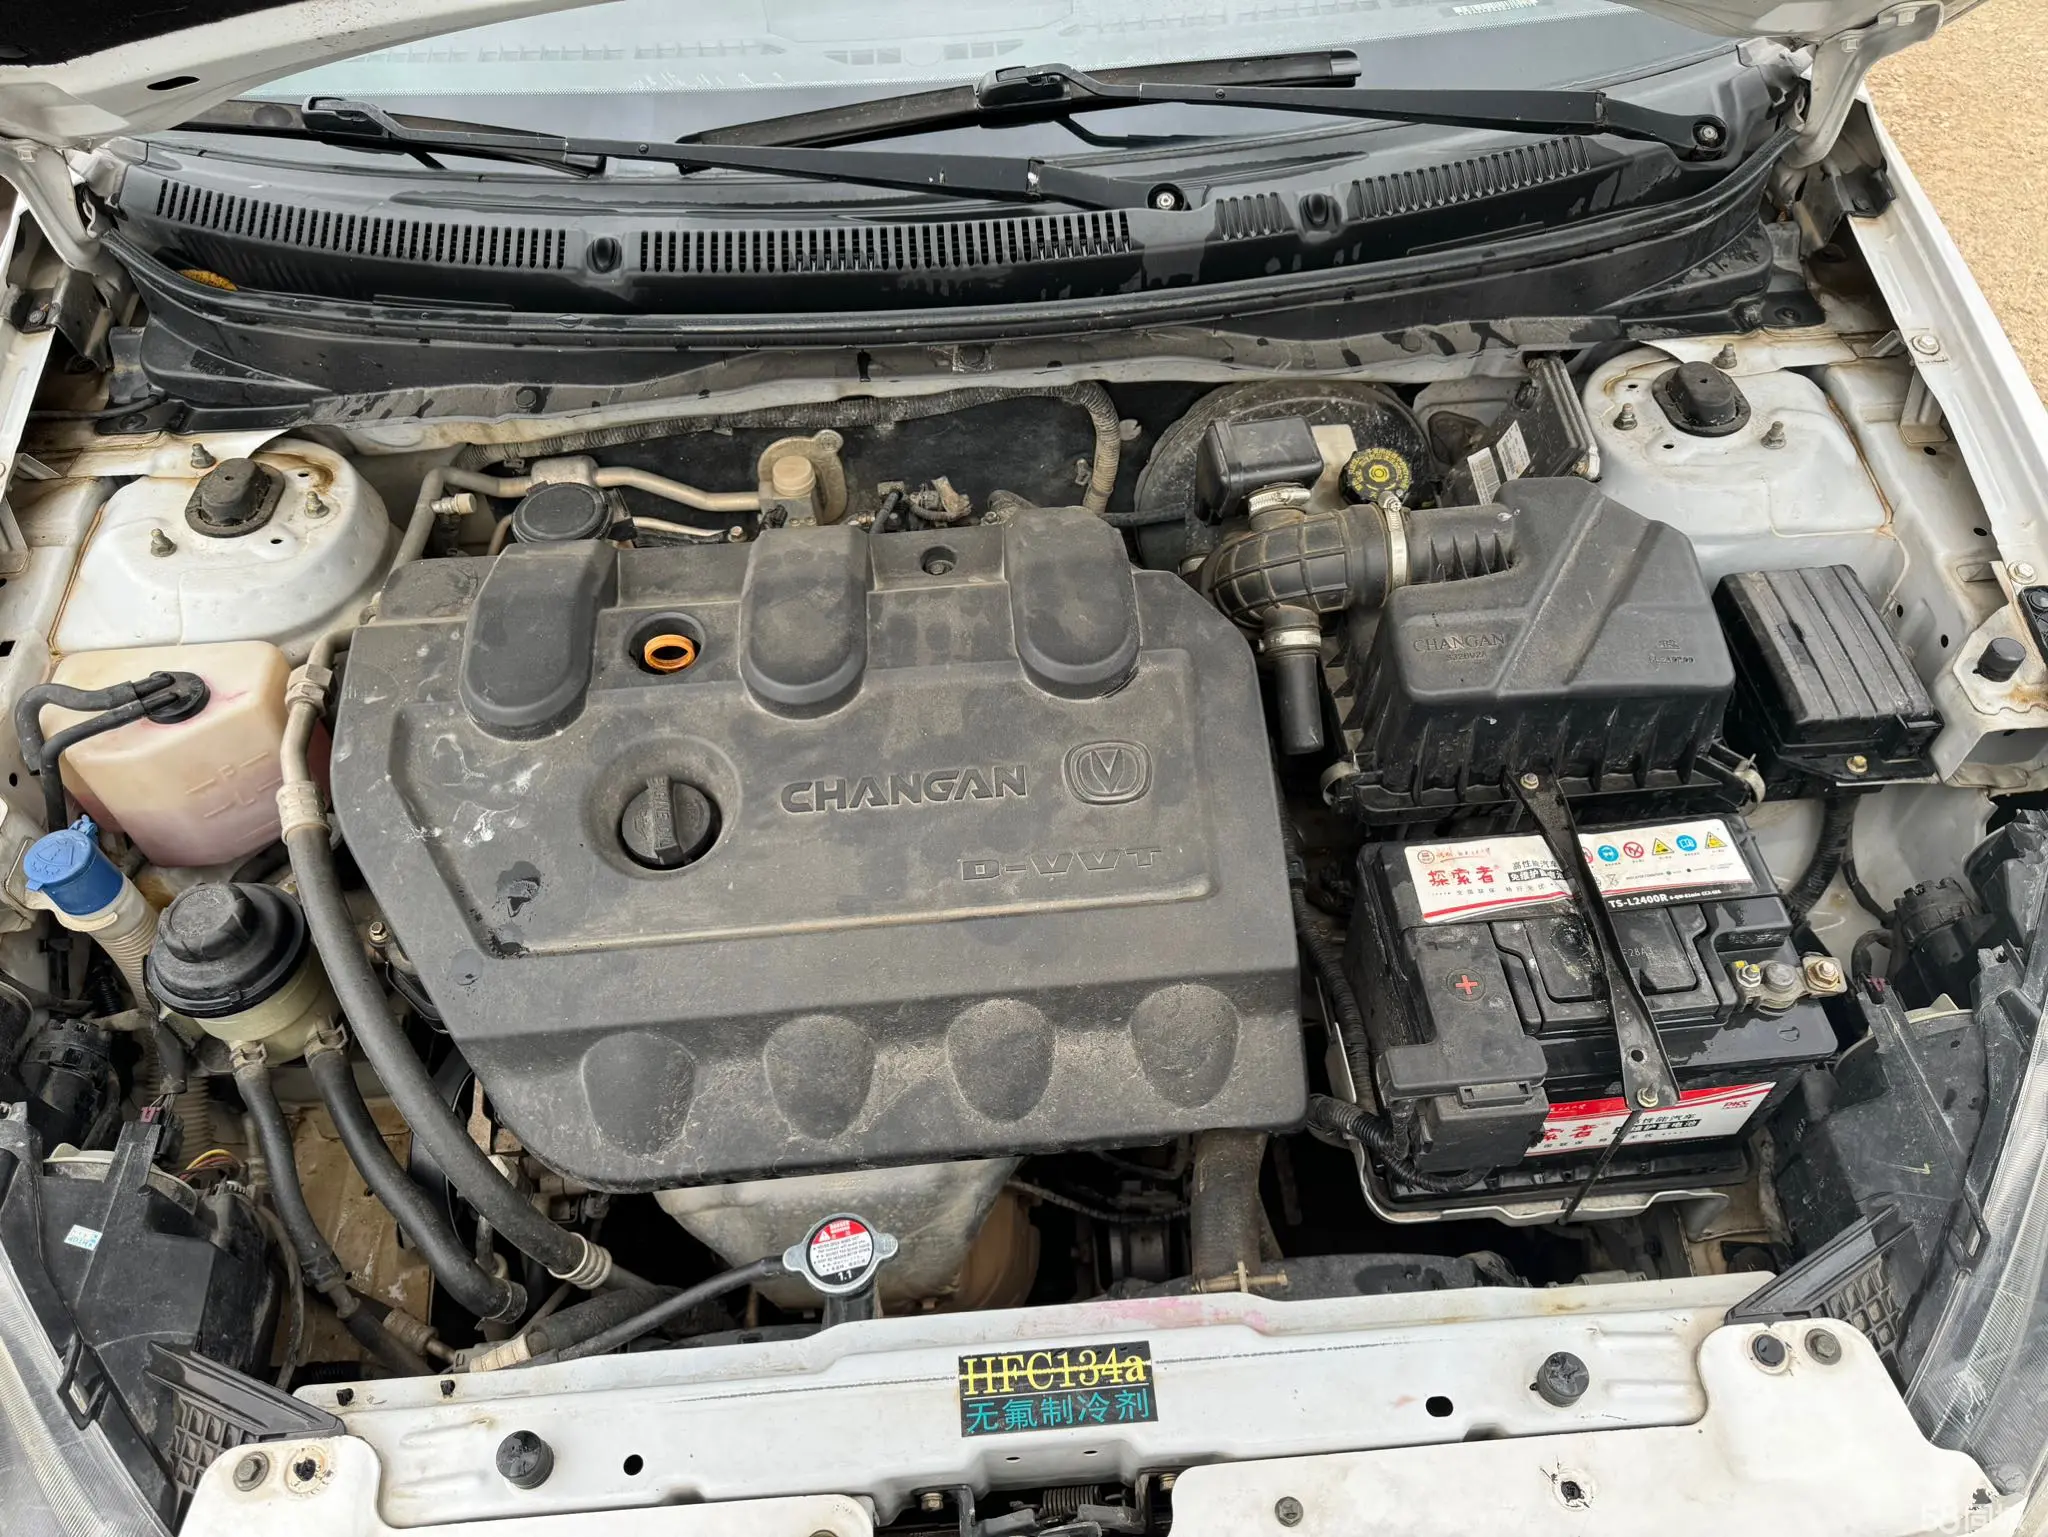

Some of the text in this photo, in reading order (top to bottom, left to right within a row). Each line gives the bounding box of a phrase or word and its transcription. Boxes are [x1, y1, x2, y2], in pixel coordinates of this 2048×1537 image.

[1413, 633, 1505, 652] CHANGAN
[781, 765, 1027, 815] CHANGAN
[961, 847, 1163, 881] D-VVT
[1427, 865, 1494, 887] 探索者
[1608, 893, 1669, 909] TS-L2400R
[837, 1270, 853, 1282] 1.1
[963, 1347, 1147, 1396] HFC134a
[966, 1388, 1150, 1434] 无氟制冷剂
